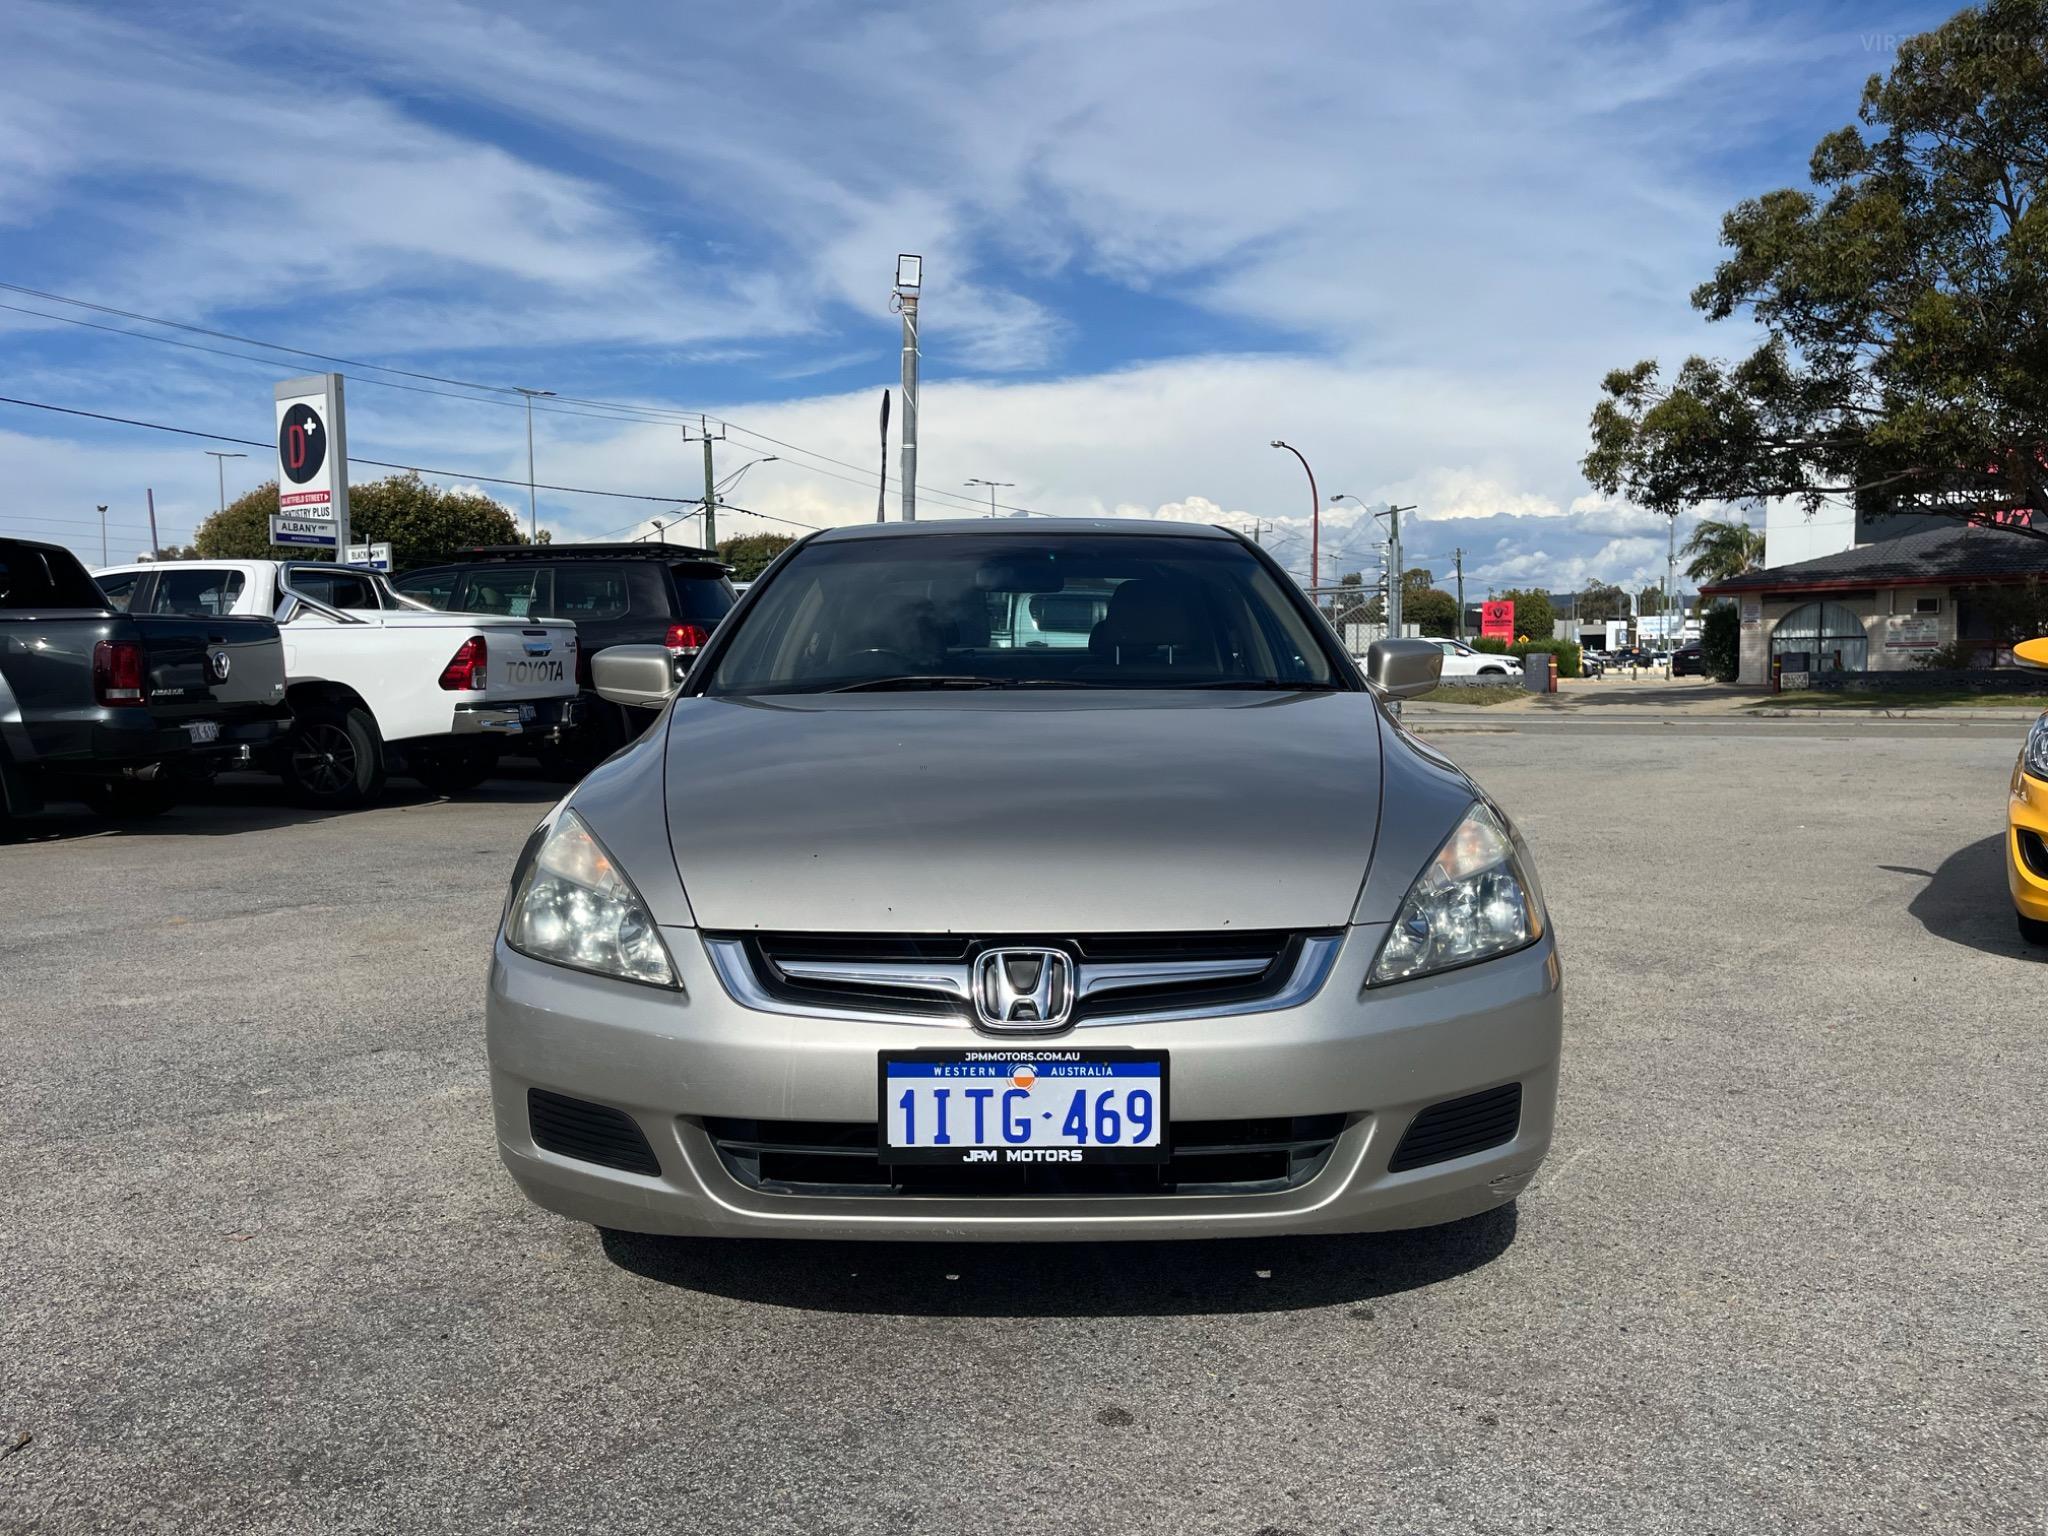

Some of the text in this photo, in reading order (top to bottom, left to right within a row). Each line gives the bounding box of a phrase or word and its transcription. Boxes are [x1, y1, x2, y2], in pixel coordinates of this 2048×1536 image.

[305, 492, 324, 503] STREET
[312, 506, 330, 517] PLUS
[281, 522, 317, 533] ALBANY
[506, 661, 563, 683] TOYOTA
[964, 1051, 1081, 1063] JPMMOTORS.COM.AU
[933, 1066, 1114, 1077] WESTERN AUSTRALIA
[962, 1149, 1083, 1163] JPM MOTORS
